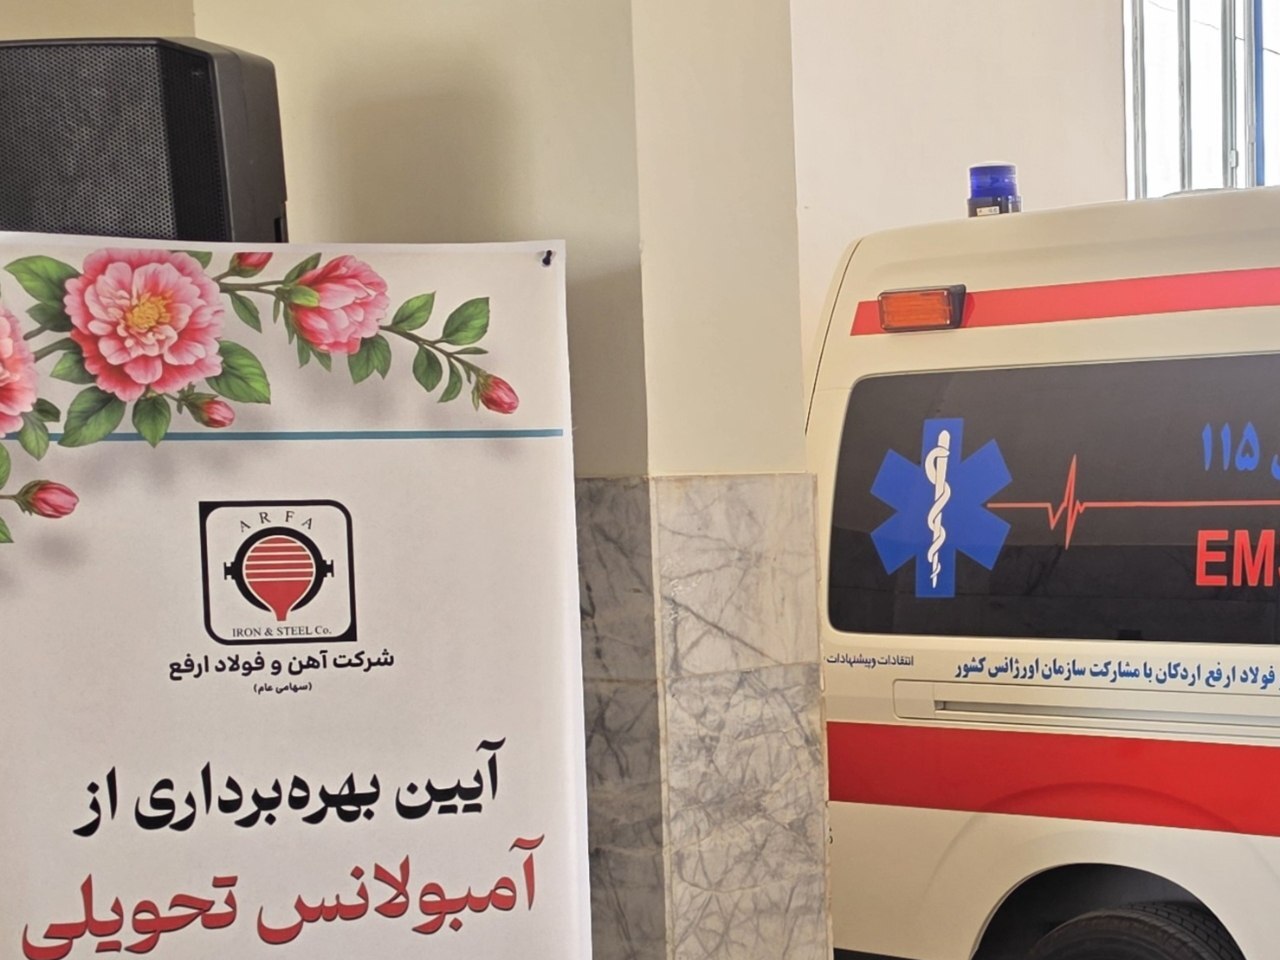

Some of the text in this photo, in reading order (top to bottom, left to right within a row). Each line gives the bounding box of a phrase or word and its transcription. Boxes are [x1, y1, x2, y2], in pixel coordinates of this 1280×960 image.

[1201, 422, 1259, 472] ۱۱۵
[239, 510, 313, 532] ARFA
[232, 625, 332, 638] IRON & STEEL Co.
[169, 648, 395, 681] شرکت آهن و فولاد ارفع
[955, 657, 986, 678] کشور
[988, 656, 1039, 680] اورژانس
[1041, 659, 1086, 681] سازمان
[1089, 661, 1140, 683] مشارکت
[1143, 661, 1153, 684] با
[1155, 662, 1201, 686] اردکان
[1204, 661, 1236, 688] ارفع
[252, 682, 313, 694] (سهامی عام)
[1240, 665, 1276, 689] فولاد
[395, 736, 507, 819] آیین
[73, 766, 118, 837] از
[256, 834, 546, 945] آمبولانس
